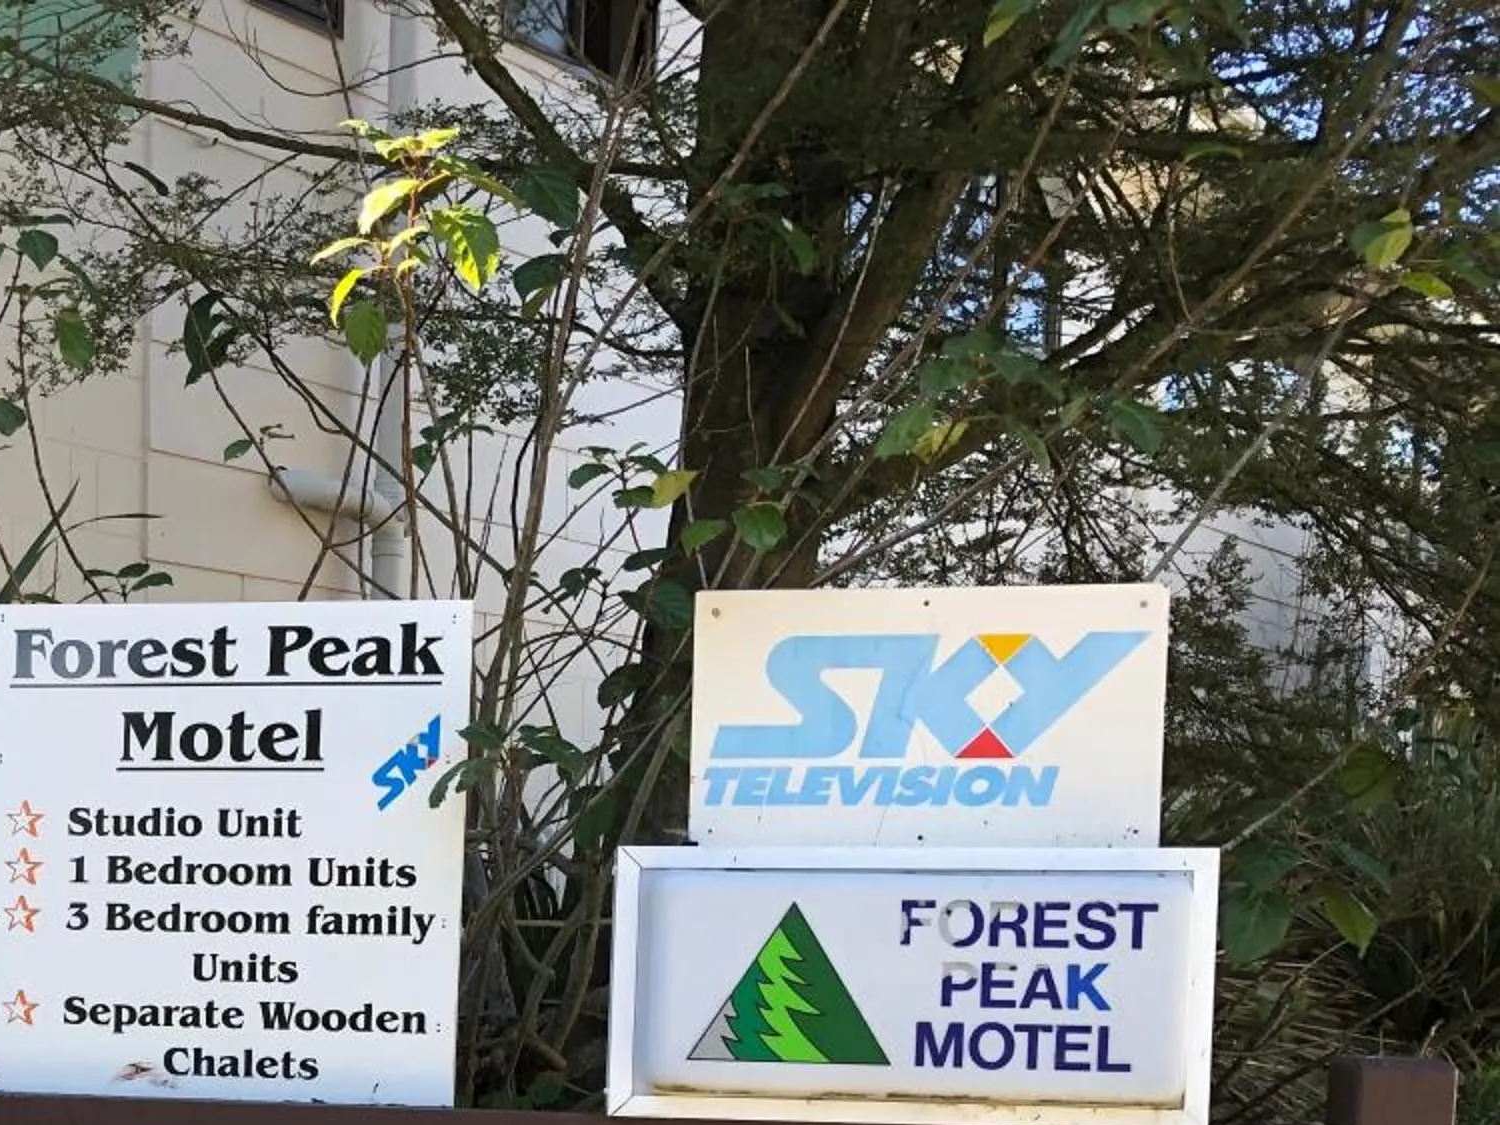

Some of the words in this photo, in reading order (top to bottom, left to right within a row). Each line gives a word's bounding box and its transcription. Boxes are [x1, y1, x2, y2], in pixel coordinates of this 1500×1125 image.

[14, 626, 239, 680] Forest
[267, 622, 444, 677] Peak
[710, 631, 1153, 760] SKY
[119, 708, 324, 763] Motel
[371, 714, 442, 812] SKY
[703, 765, 1060, 808] TELEVISION
[67, 807, 202, 838] Studio
[217, 808, 303, 838] Unit
[68, 856, 89, 884] 1
[106, 855, 293, 887] Bedroom
[307, 857, 418, 888] Units
[65, 902, 89, 931] 3
[105, 902, 290, 935] Bedroom
[306, 905, 436, 945] family
[899, 899, 1160, 951] FOREST
[193, 953, 299, 984] Units
[939, 961, 1113, 1012] PEAK
[63, 996, 245, 1034] Separate
[259, 1001, 426, 1034] Wooden
[163, 1047, 320, 1080] Chalets
[913, 1021, 1132, 1074] MOTEL
